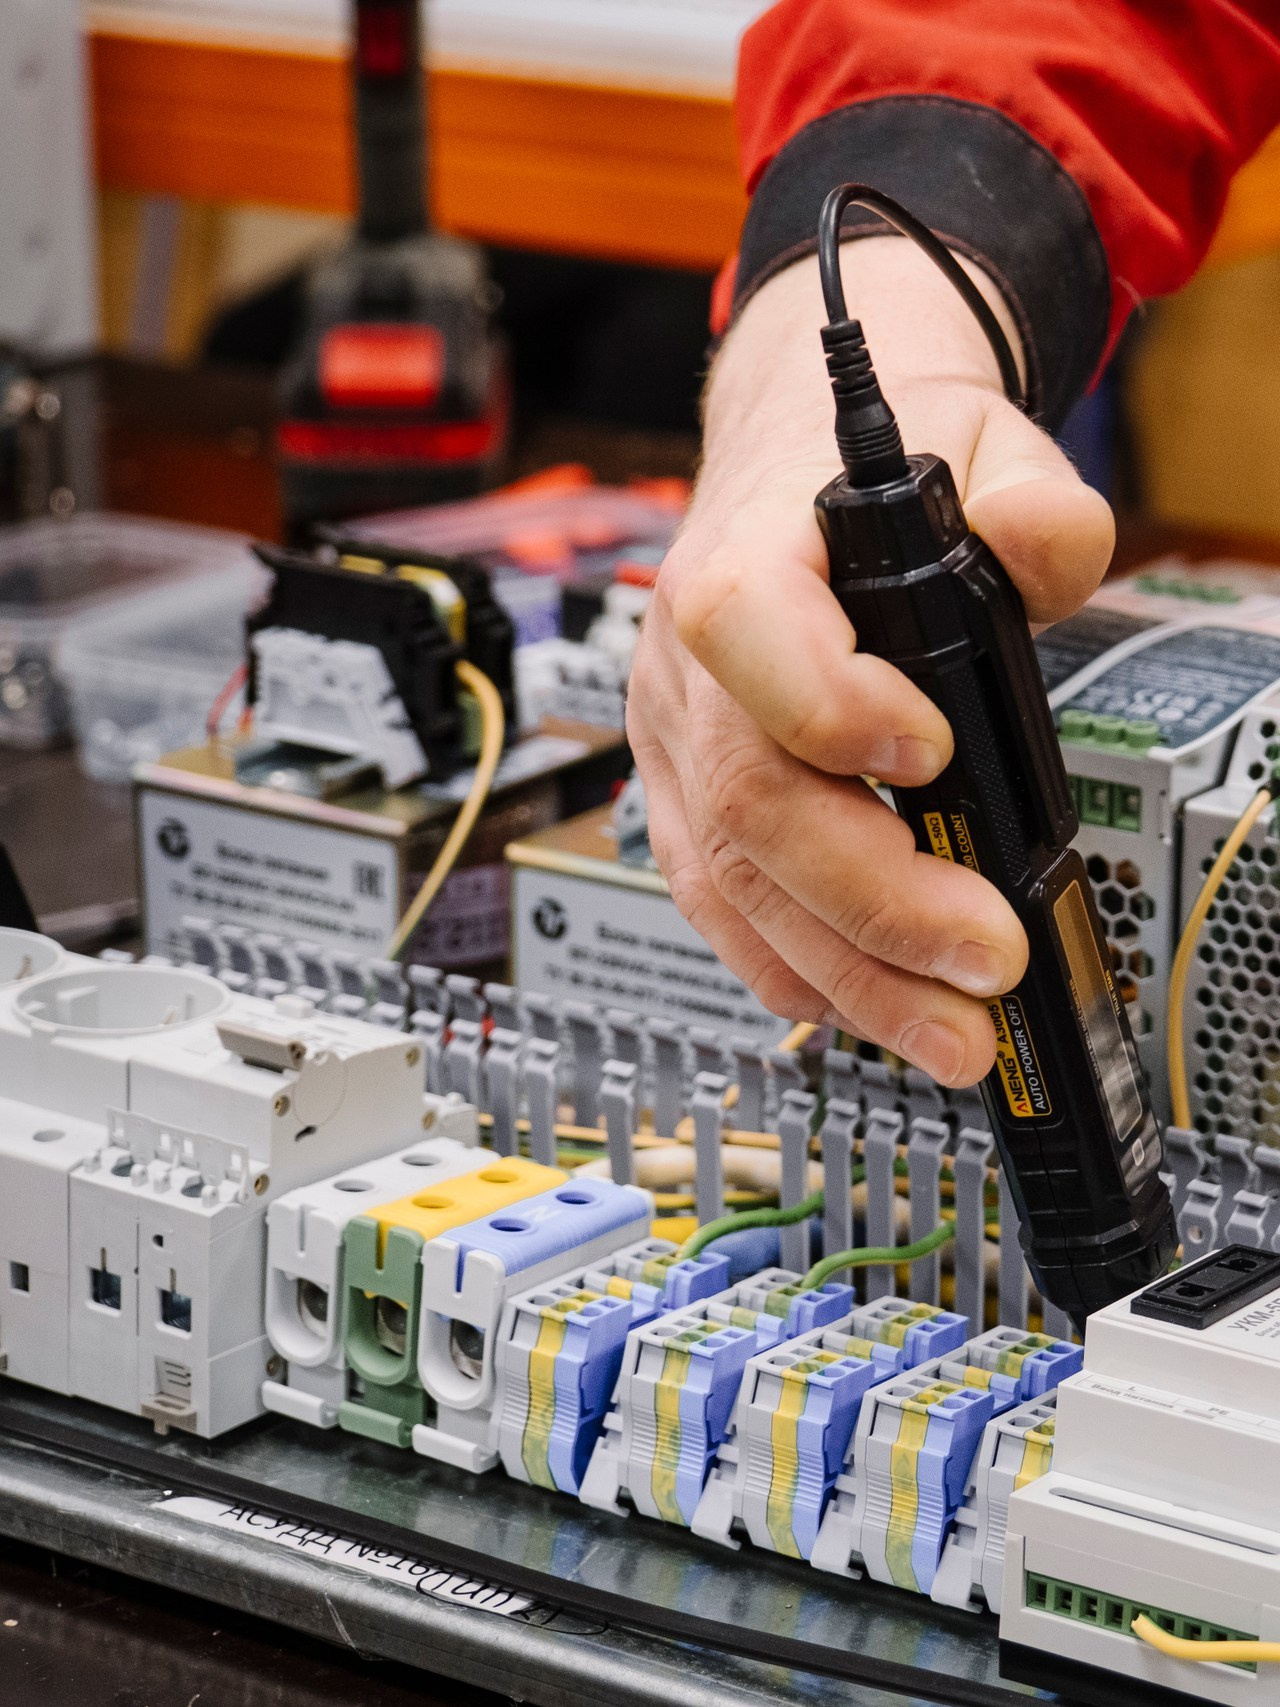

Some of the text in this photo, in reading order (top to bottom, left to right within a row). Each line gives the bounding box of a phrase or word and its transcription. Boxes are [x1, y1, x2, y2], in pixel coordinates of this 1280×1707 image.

[950, 812, 975, 869] 00 COUNT
[988, 1003, 1009, 1045] A3005
[1005, 1001, 1047, 1110] AUTO POWER OFF
